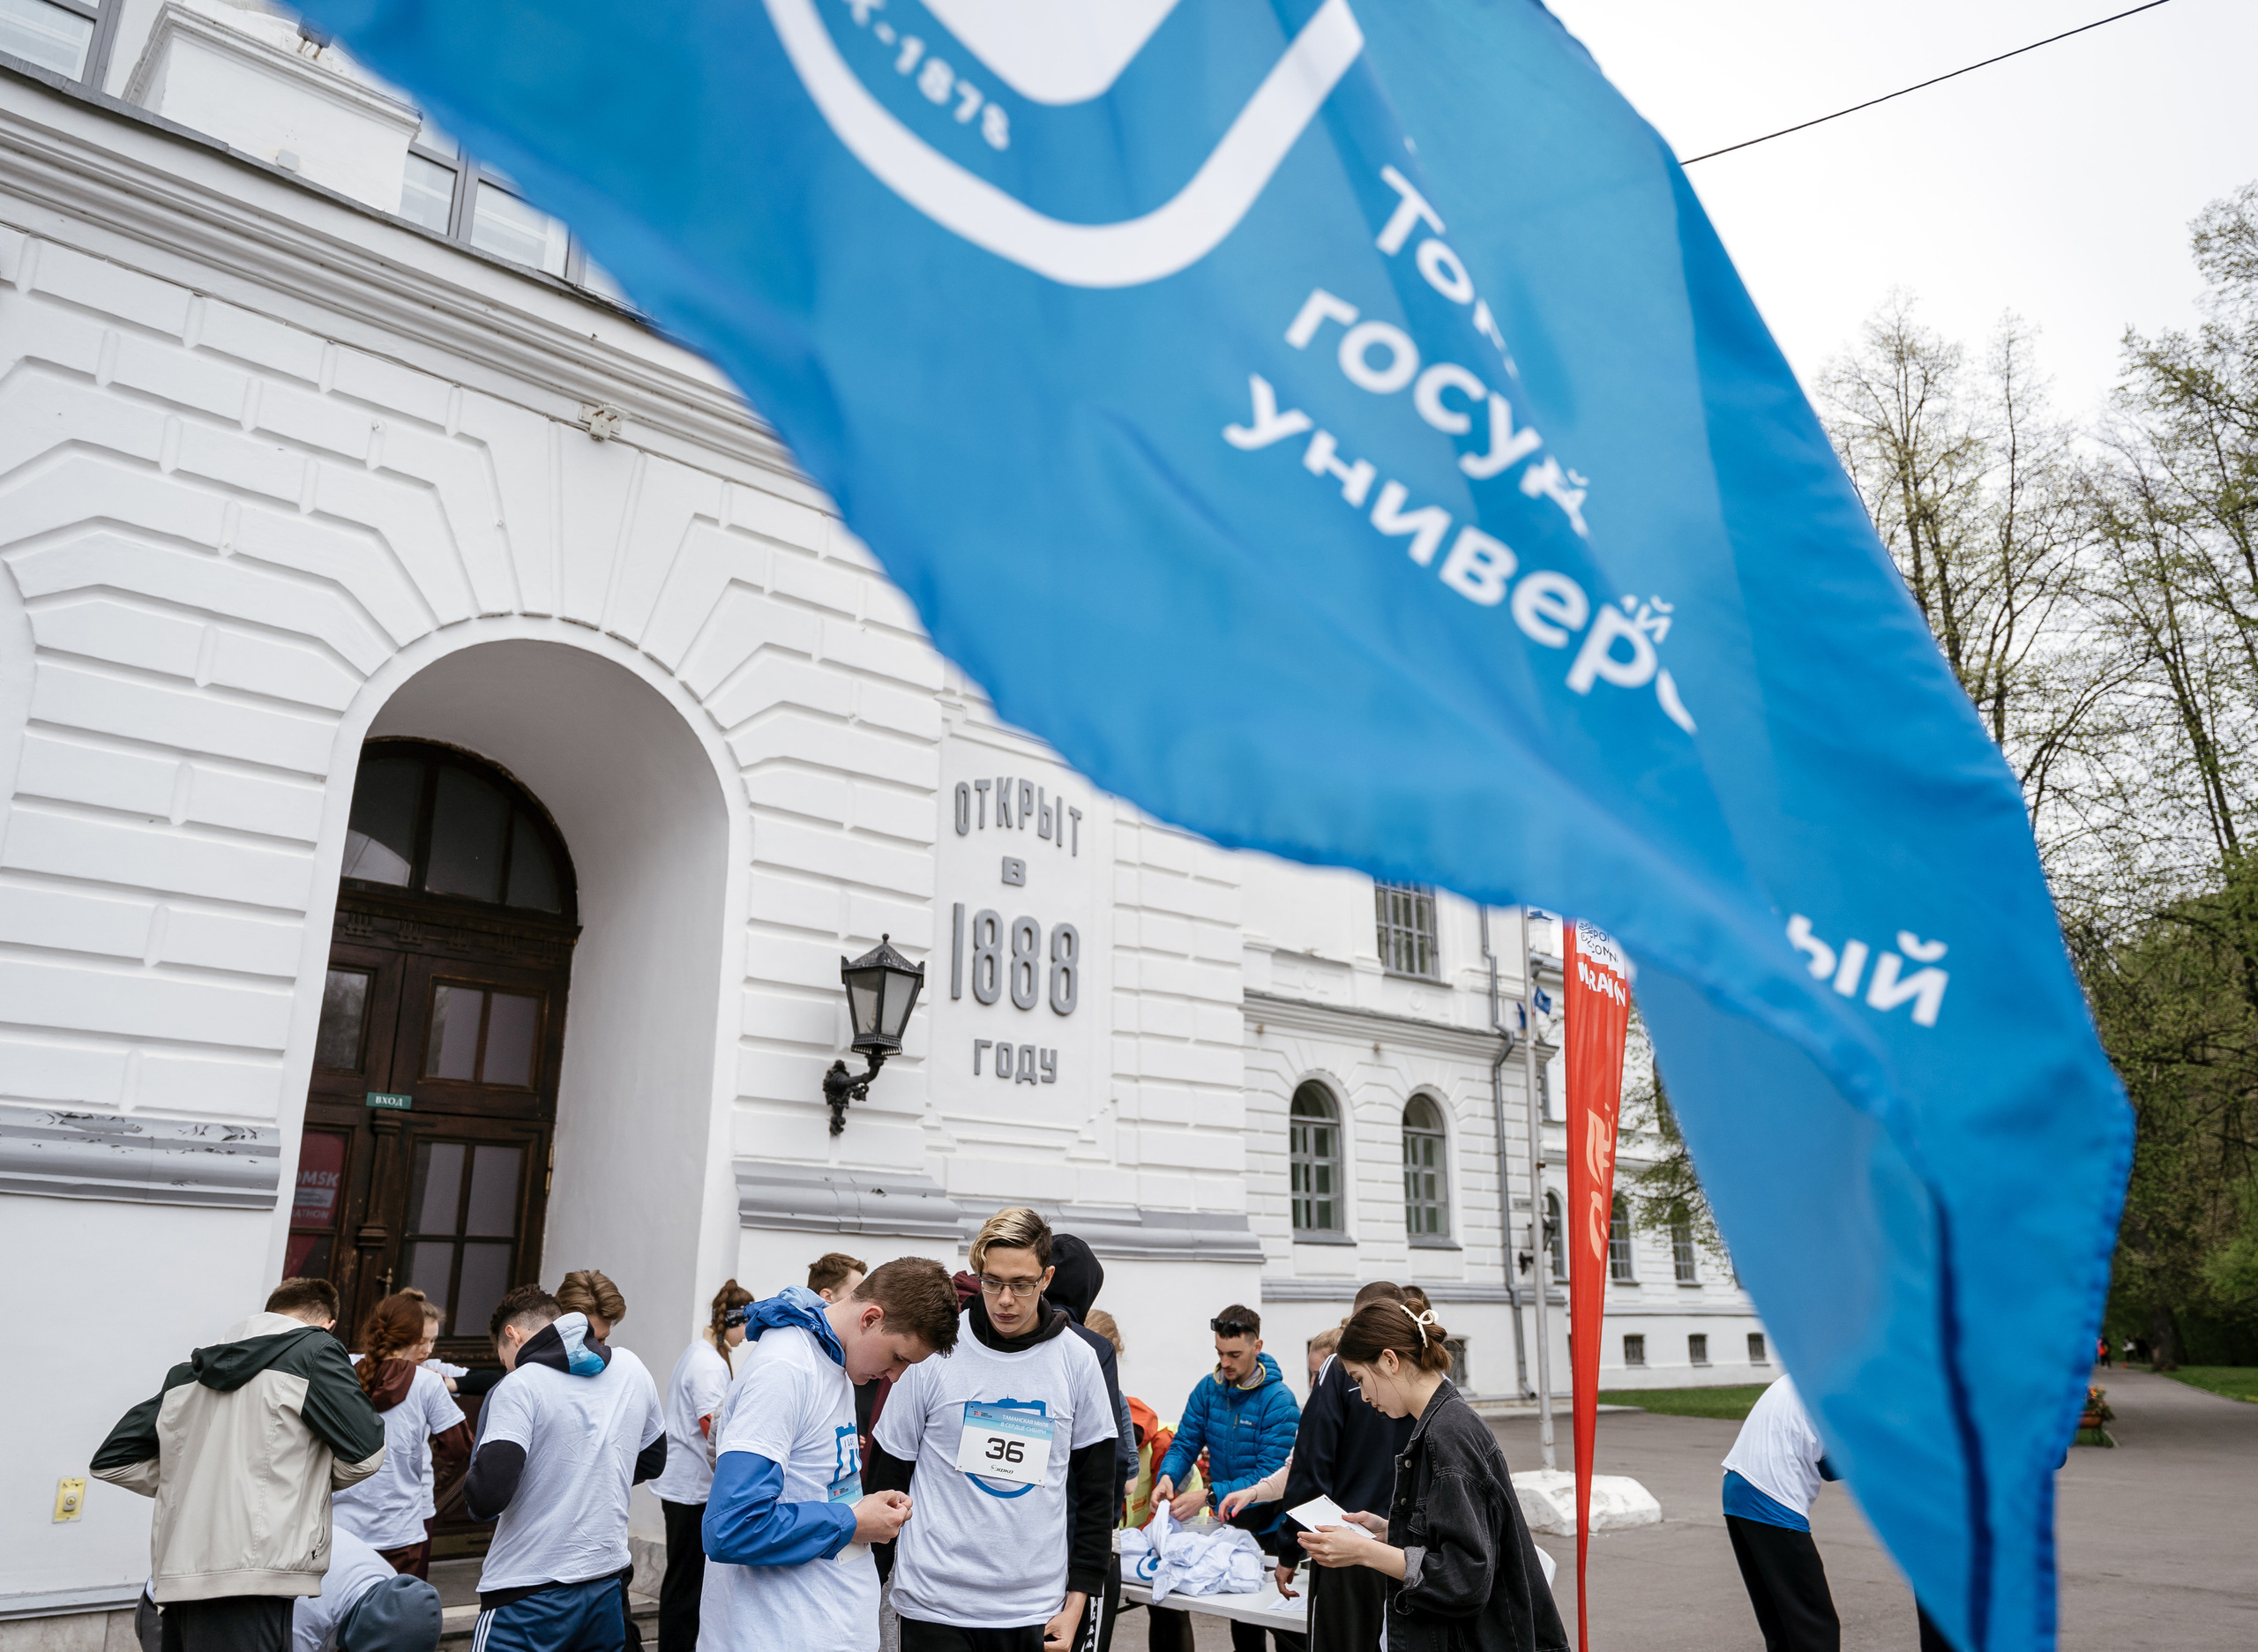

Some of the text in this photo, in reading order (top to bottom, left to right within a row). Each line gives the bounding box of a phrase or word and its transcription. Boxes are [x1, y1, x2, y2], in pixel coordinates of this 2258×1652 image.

[955, 776, 1082, 856] ОТКРЫТ
[1001, 856, 1026, 886] В
[951, 902, 1080, 1016] 1888
[973, 1038, 1058, 1085] ГОДУ
[375, 1095, 403, 1107] ВХОД
[293, 1208, 330, 1219] ATHON
[1002, 1414, 1034, 1425] ТАМАНСКАЯ
[1005, 1423, 1026, 1431] СЕРДЦЕ
[1026, 1426, 1047, 1435] СИБИРИ
[985, 1437, 1025, 1463] 36
